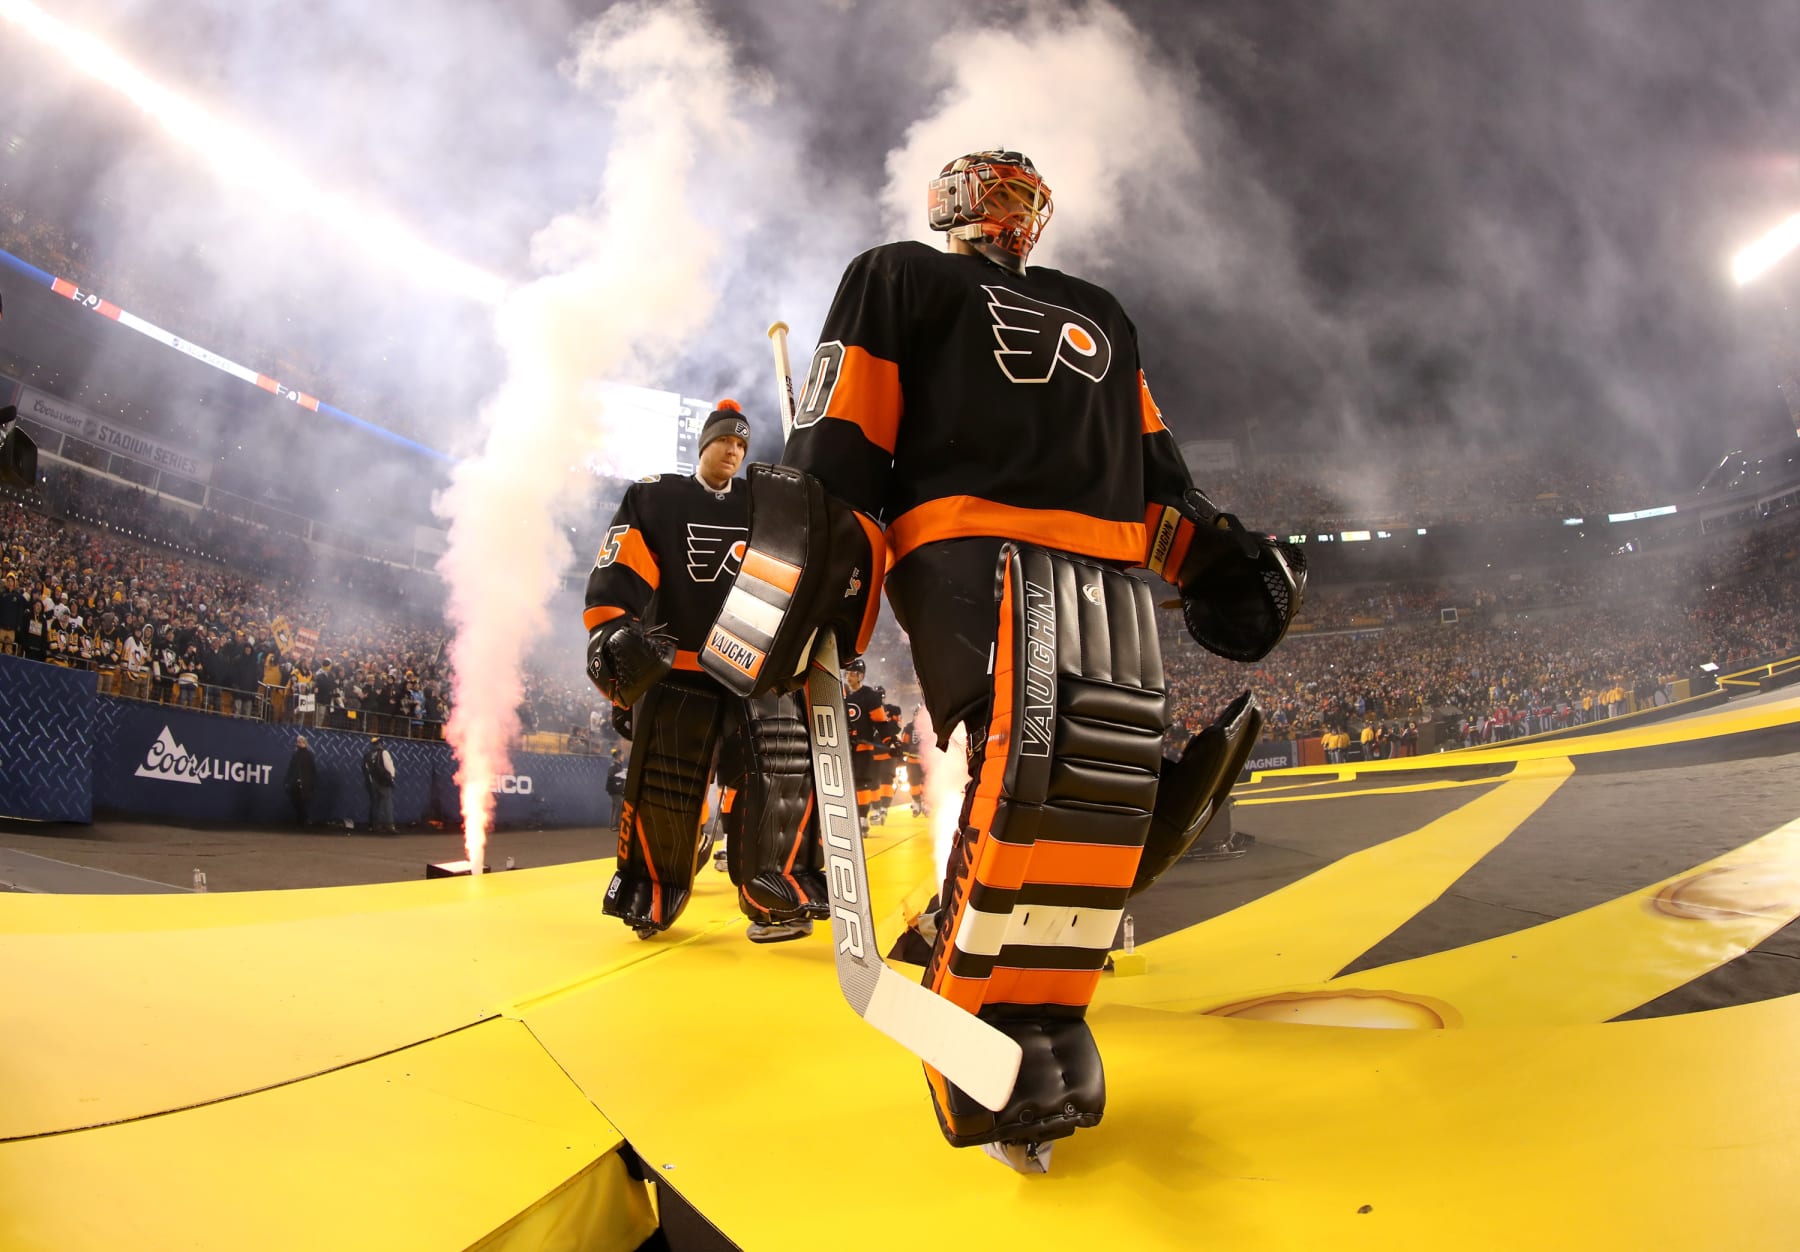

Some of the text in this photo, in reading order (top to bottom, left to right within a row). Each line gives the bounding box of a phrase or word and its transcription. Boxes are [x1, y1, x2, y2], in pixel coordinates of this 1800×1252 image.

[98, 424, 153, 457] STADIUM
[154, 447, 198, 474] SERIES
[711, 631, 757, 670] VAUGHN
[1020, 581, 1056, 757] VAUGHN
[141, 739, 273, 785] Coors LIGHT
[617, 800, 634, 861] CCM
